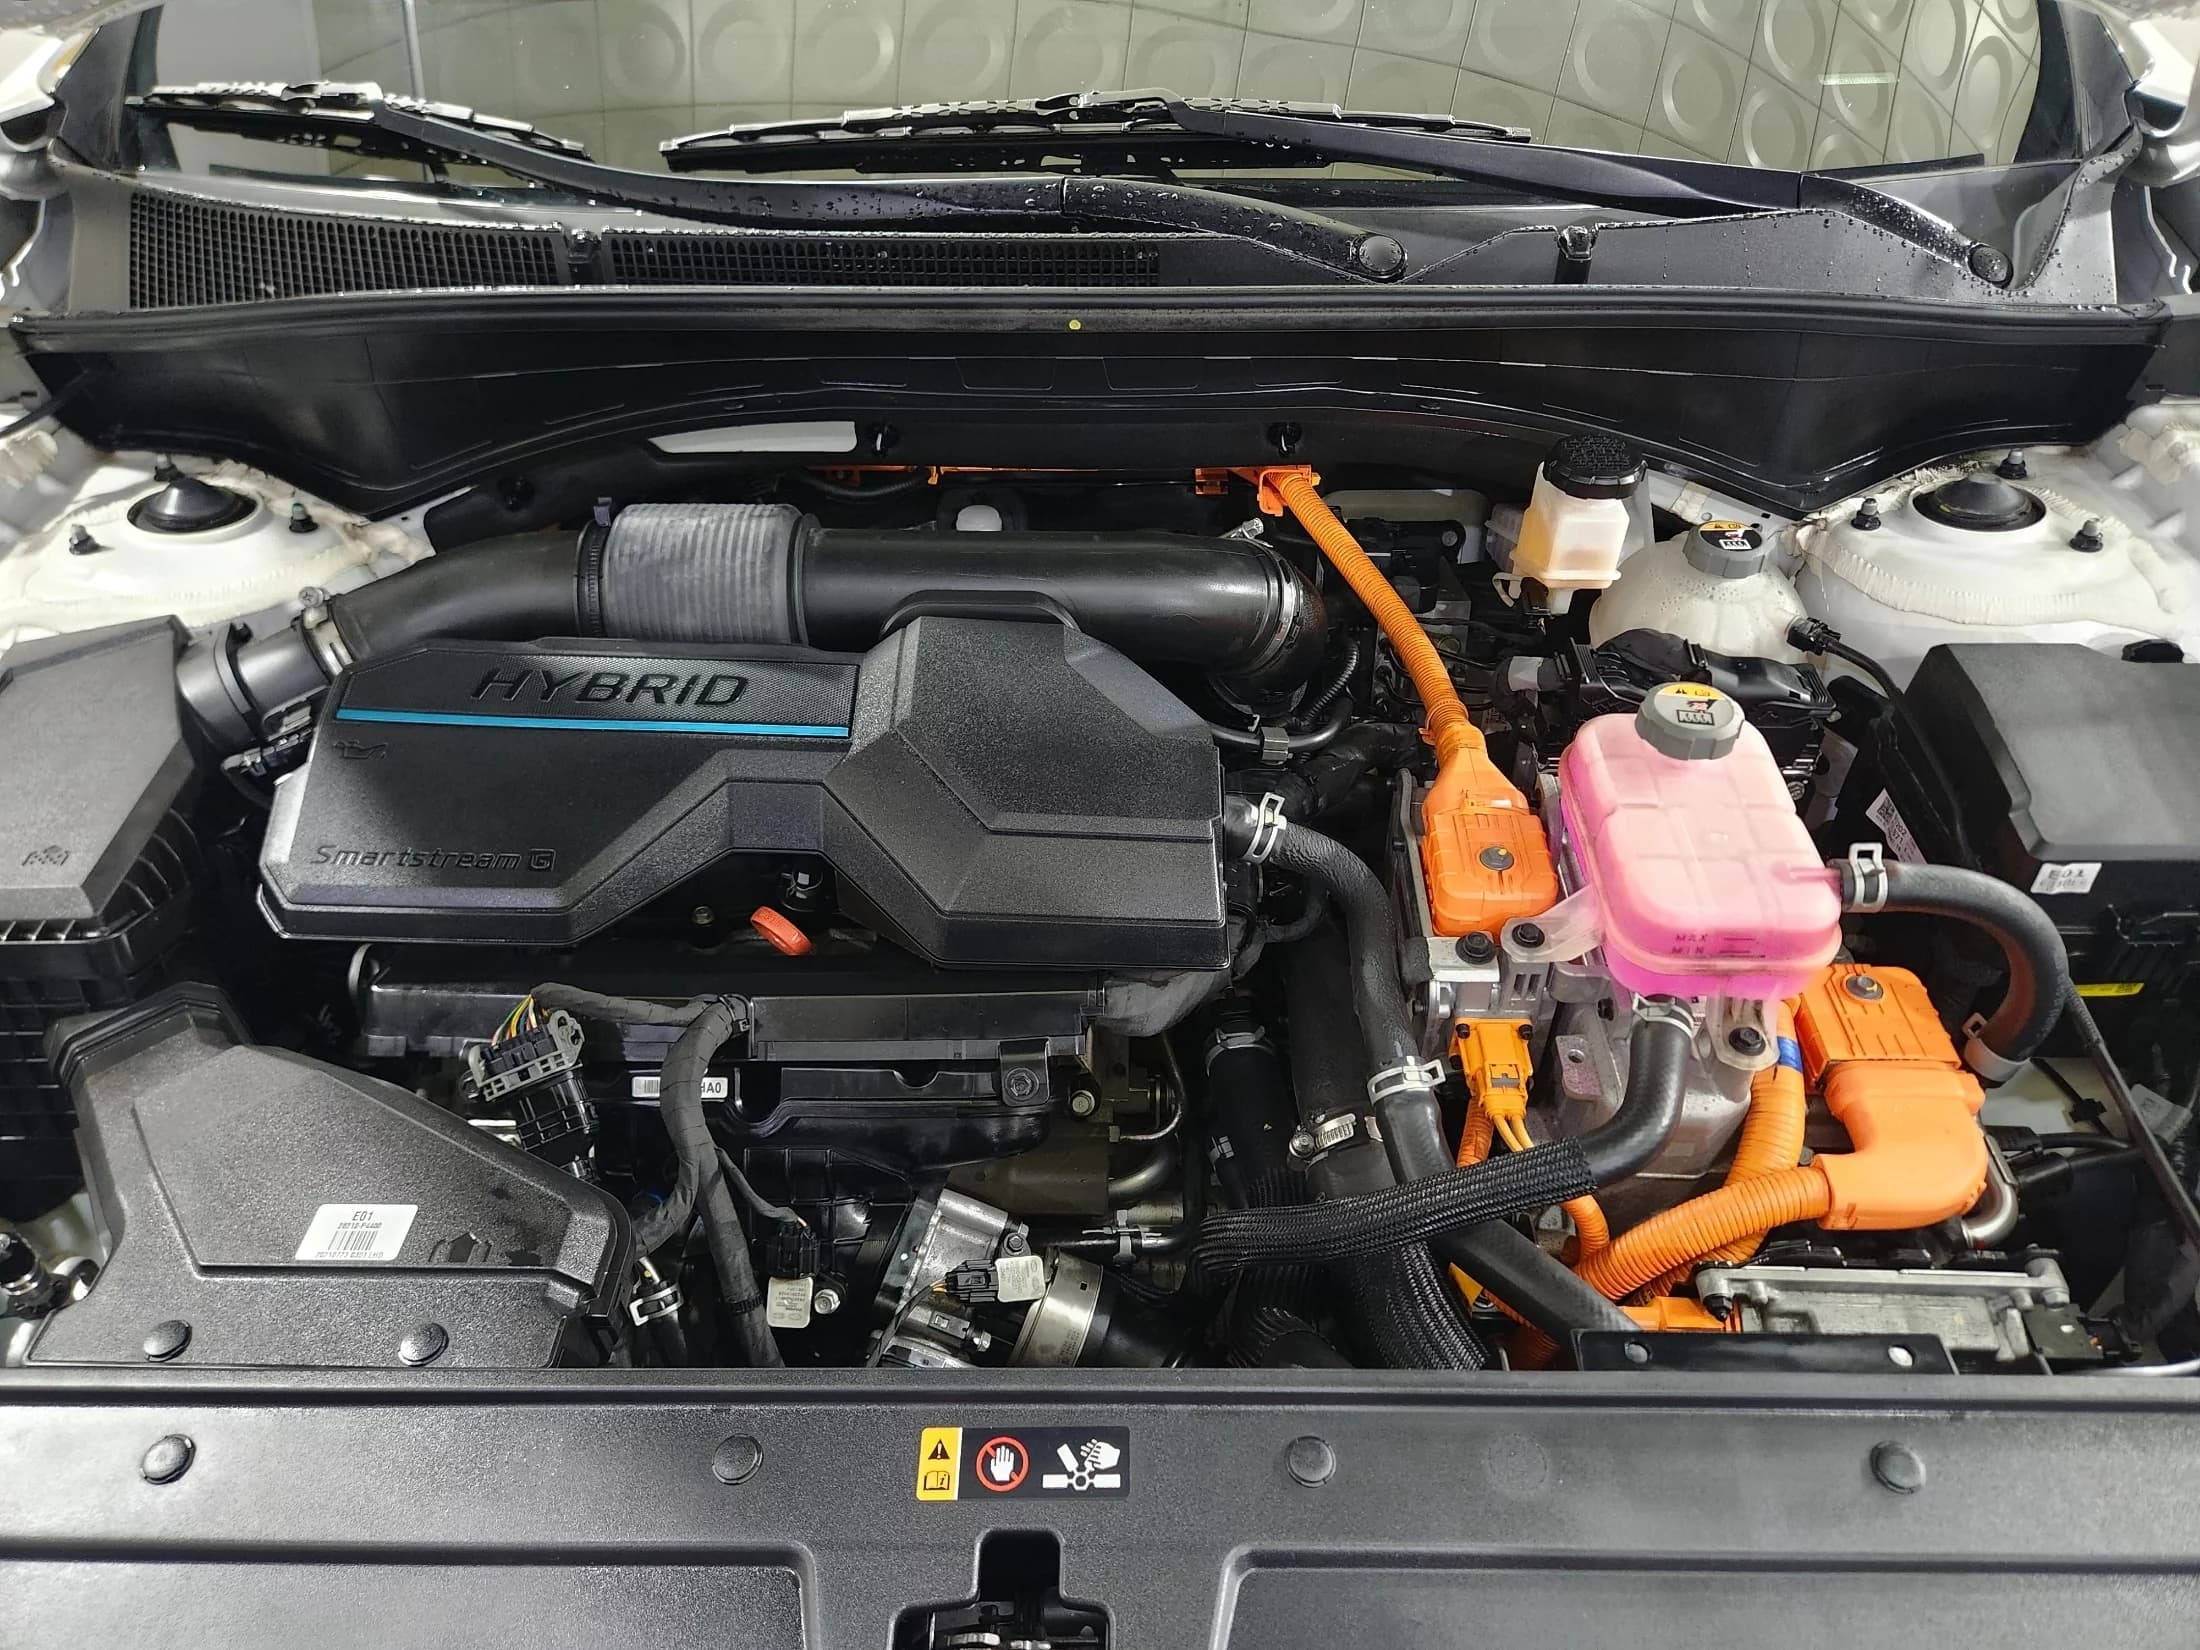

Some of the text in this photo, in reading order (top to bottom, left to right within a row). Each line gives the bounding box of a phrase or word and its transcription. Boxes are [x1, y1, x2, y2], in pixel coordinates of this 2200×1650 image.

[471, 669, 748, 706] HYBRID
[310, 845, 522, 870] Smartstream
[352, 1211, 374, 1222] E01
